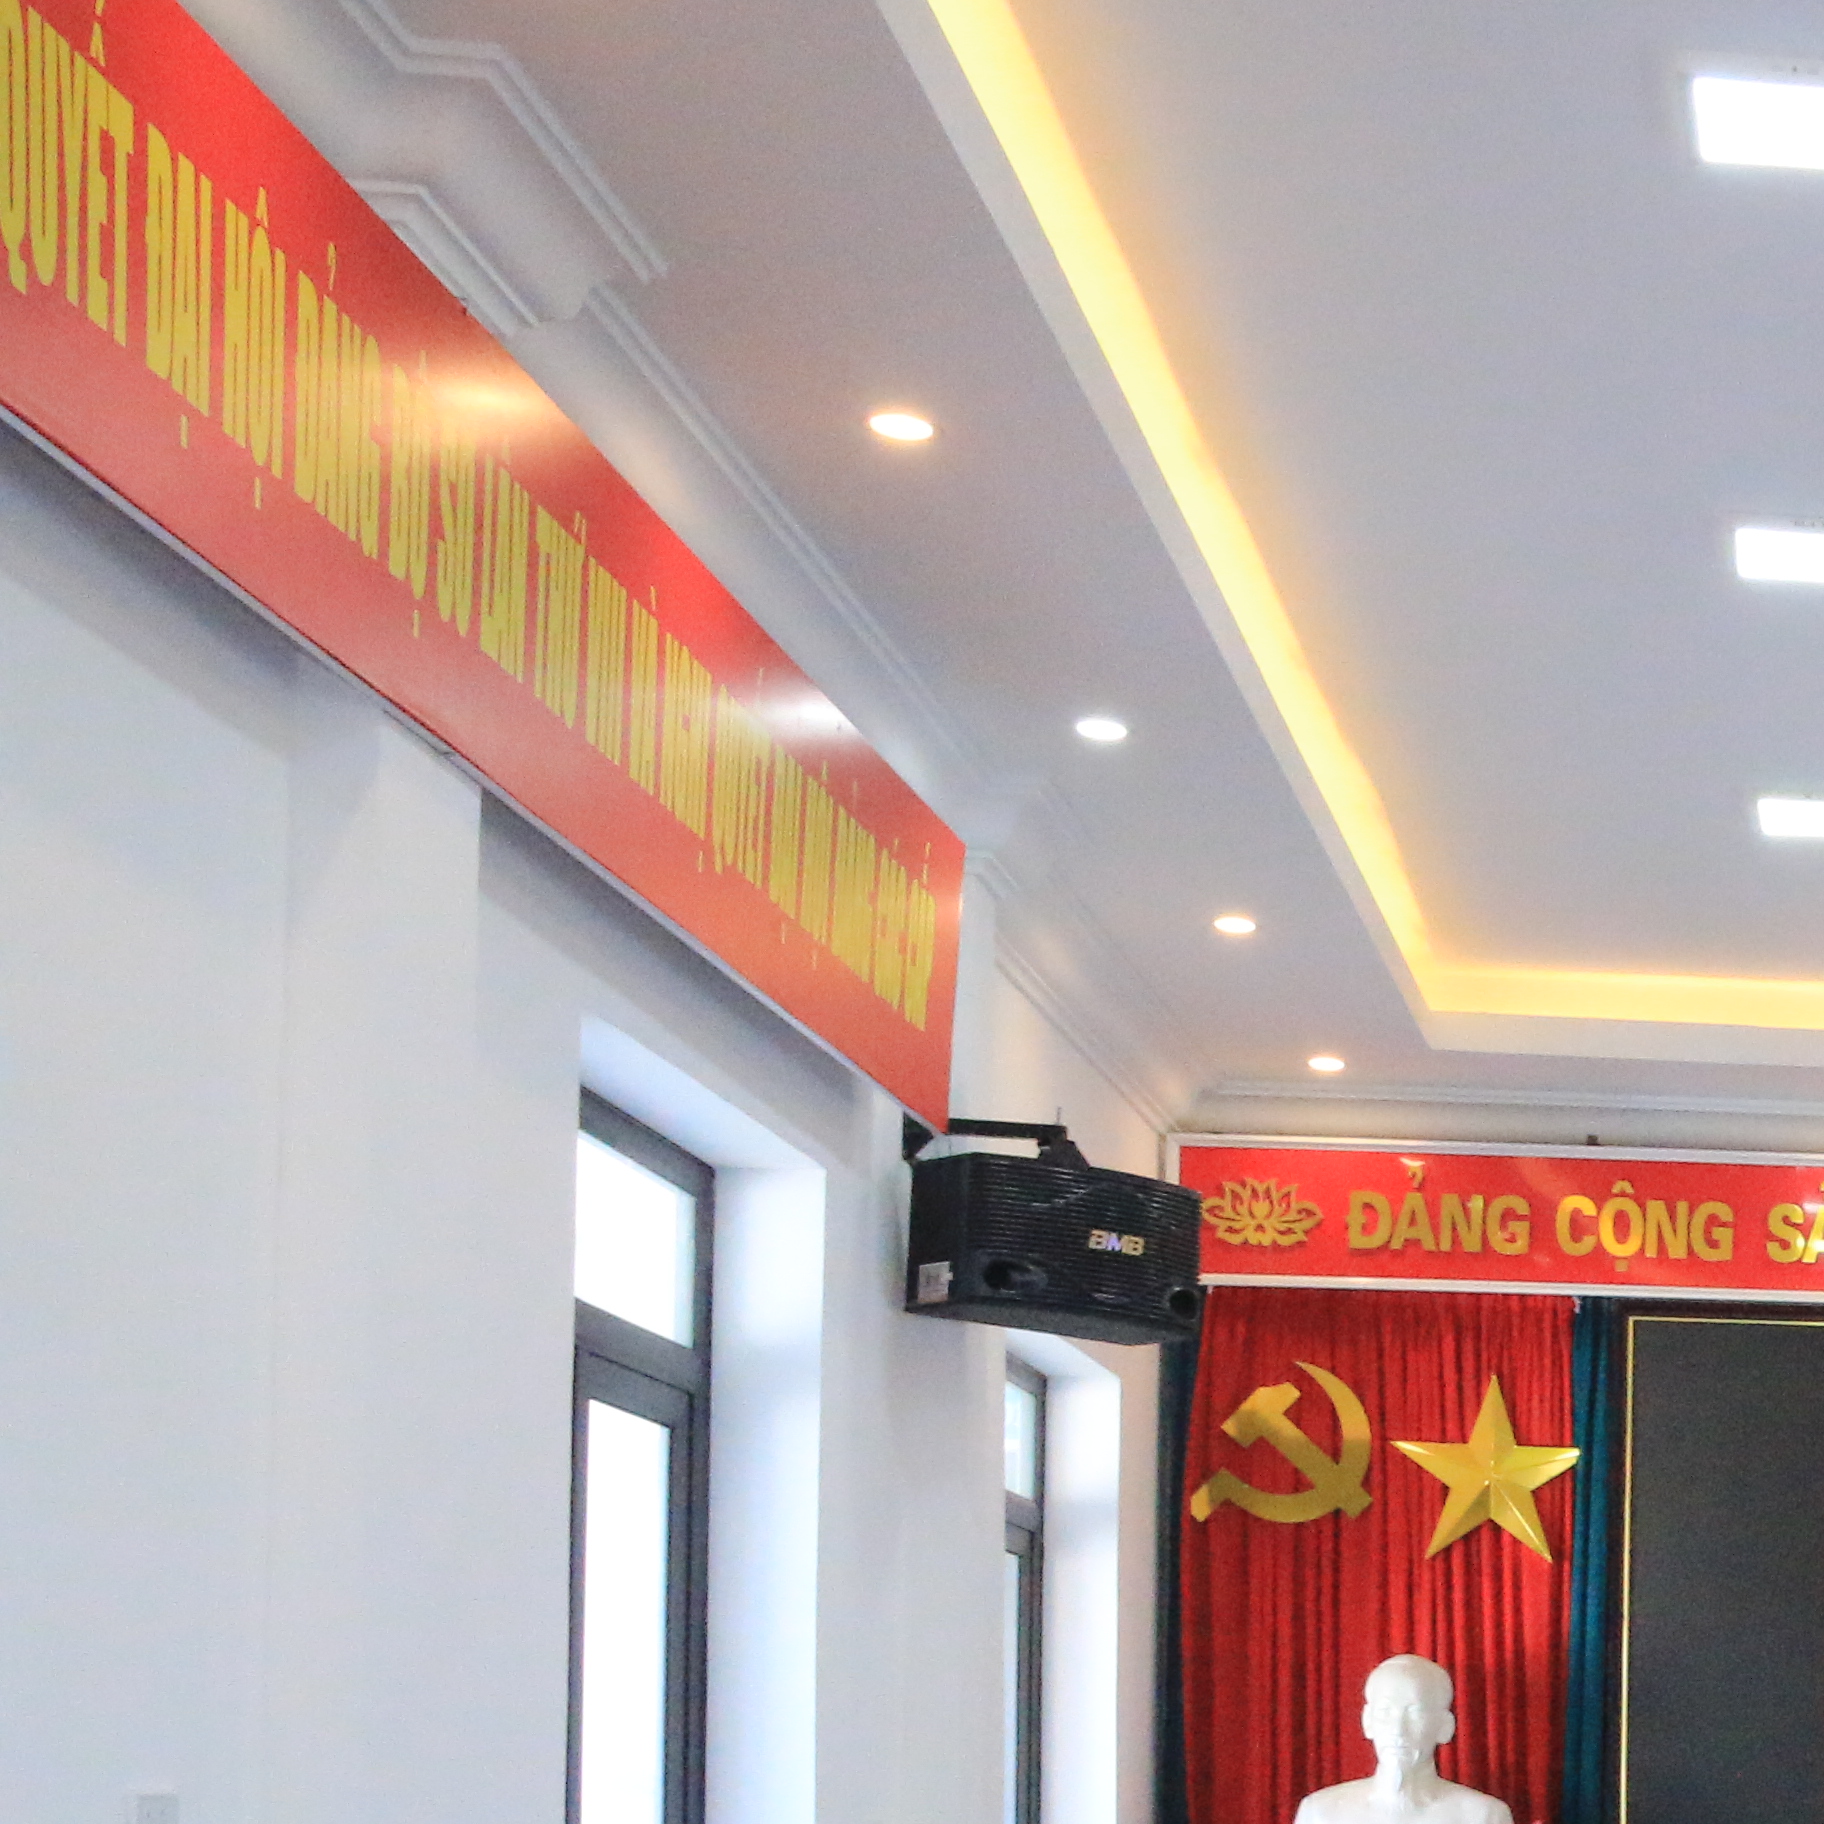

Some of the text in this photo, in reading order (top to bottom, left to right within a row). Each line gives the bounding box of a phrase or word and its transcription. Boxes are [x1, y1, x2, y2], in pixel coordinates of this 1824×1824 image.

[145, 122, 213, 449] ĐẠI
[223, 186, 287, 510] HỘI
[294, 242, 381, 560] ĐẢNG
[533, 505, 587, 730] THỨ
[628, 585, 660, 796] VÀ
[658, 632, 713, 873] NGHỊ
[1345, 1161, 1531, 1256] ĐẢNG
[1556, 1179, 1734, 1272] CỘNG
